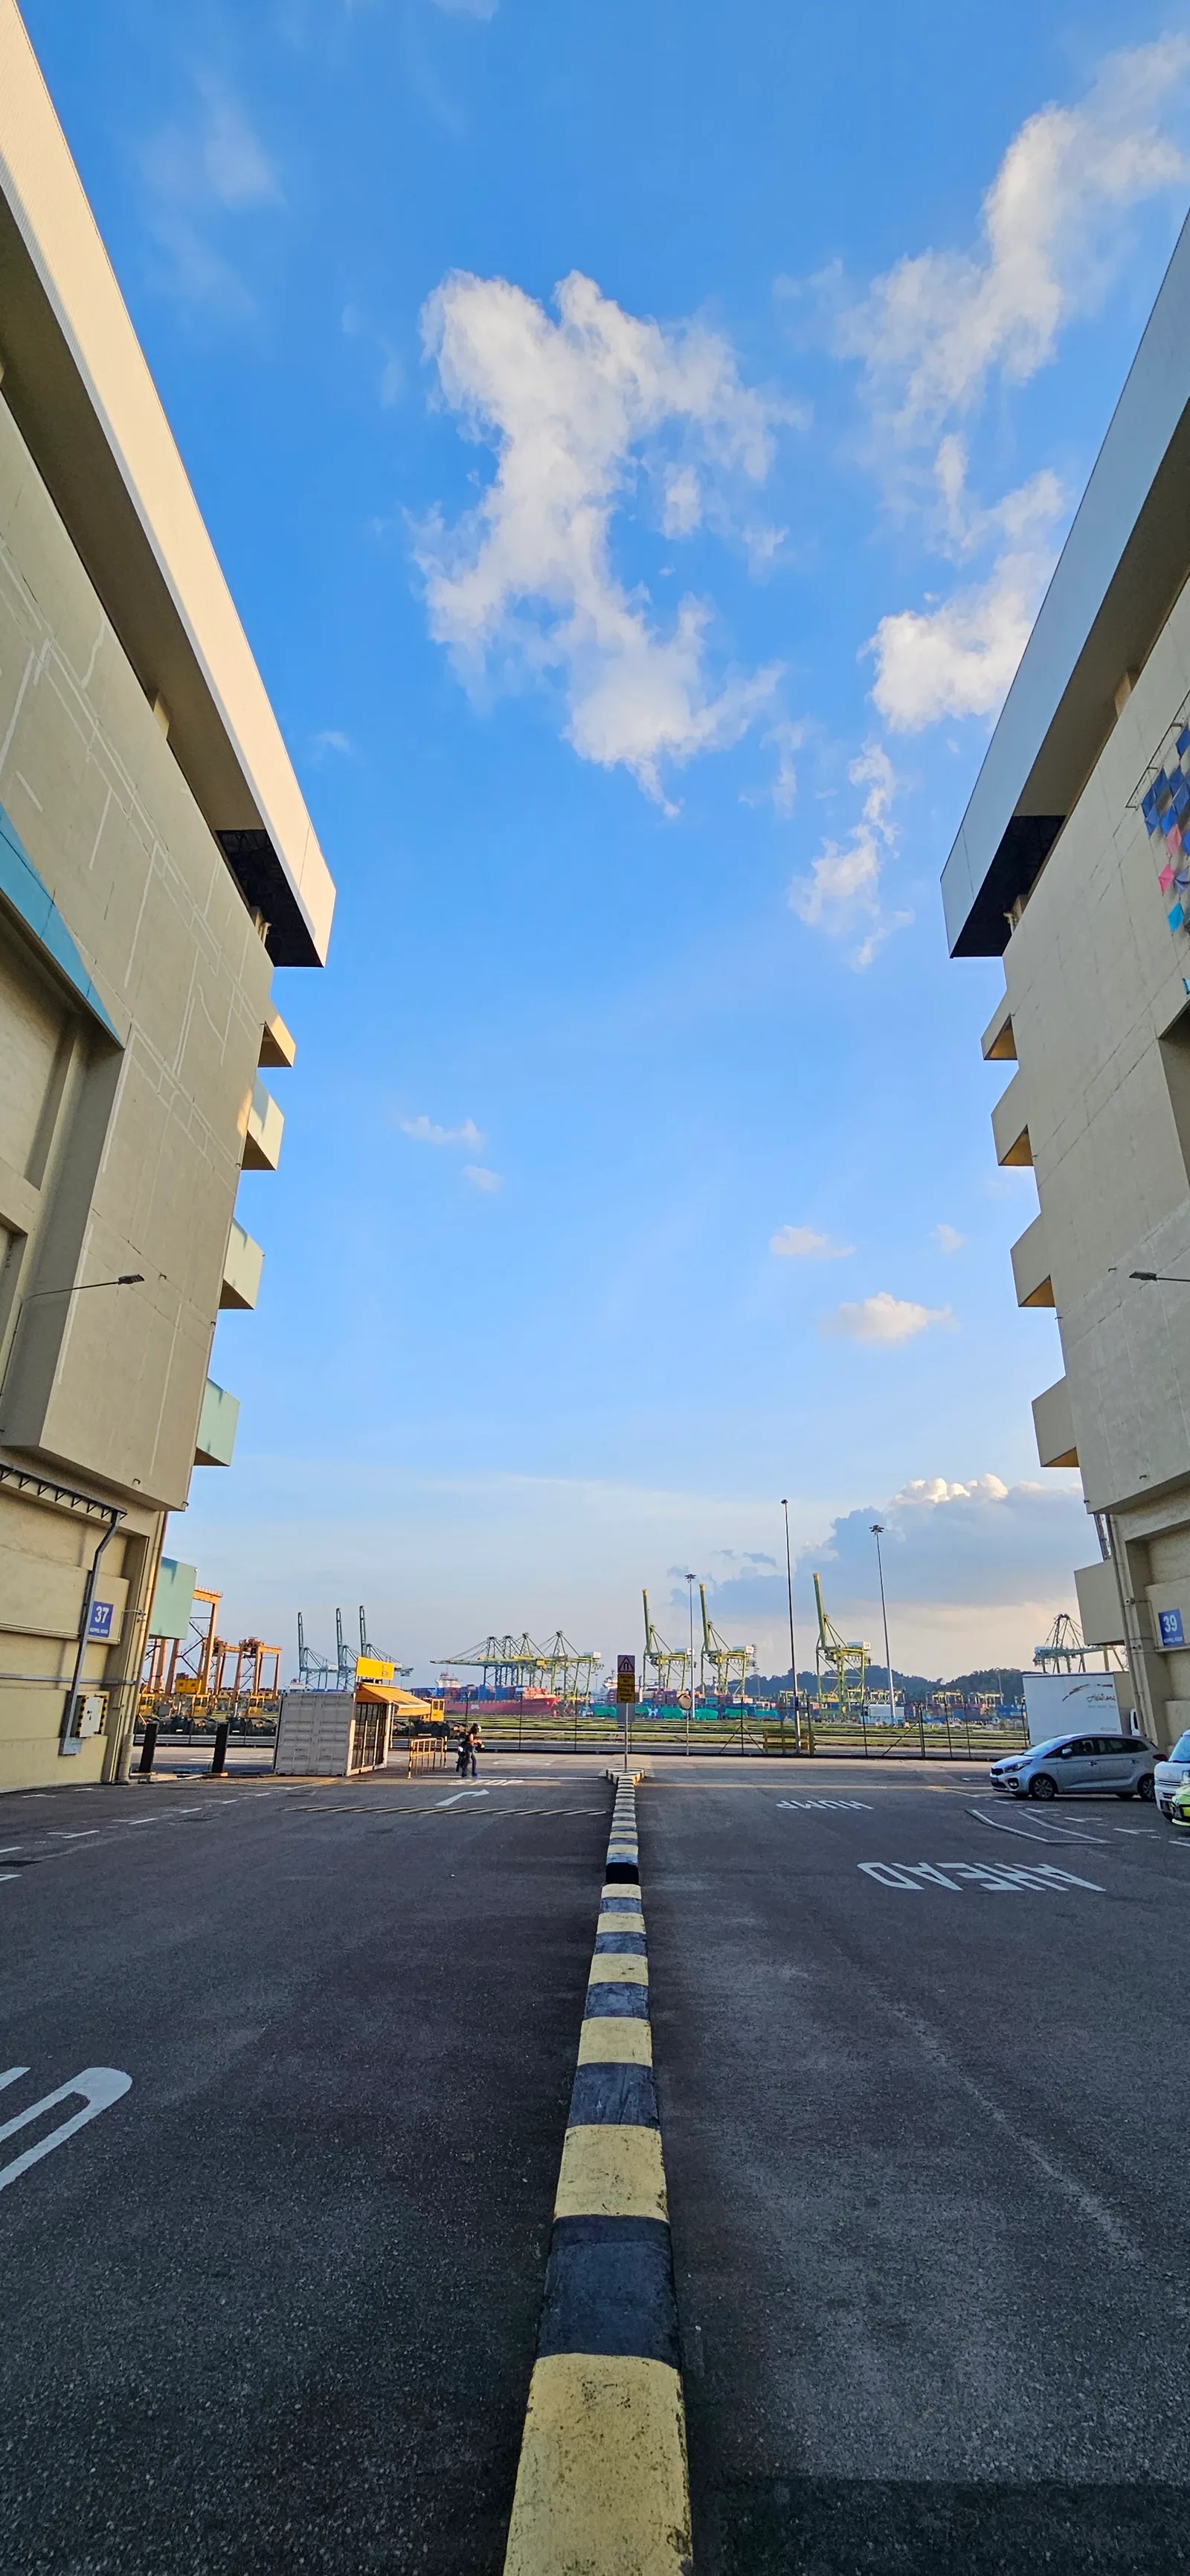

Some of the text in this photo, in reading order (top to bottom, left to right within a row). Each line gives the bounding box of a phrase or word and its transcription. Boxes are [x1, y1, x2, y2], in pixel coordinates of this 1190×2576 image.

[94, 1606, 109, 1623] 37
[1162, 1615, 1177, 1633] 39
[776, 1800, 875, 1810] HUMP
[857, 1862, 1107, 1892] AHEAD
